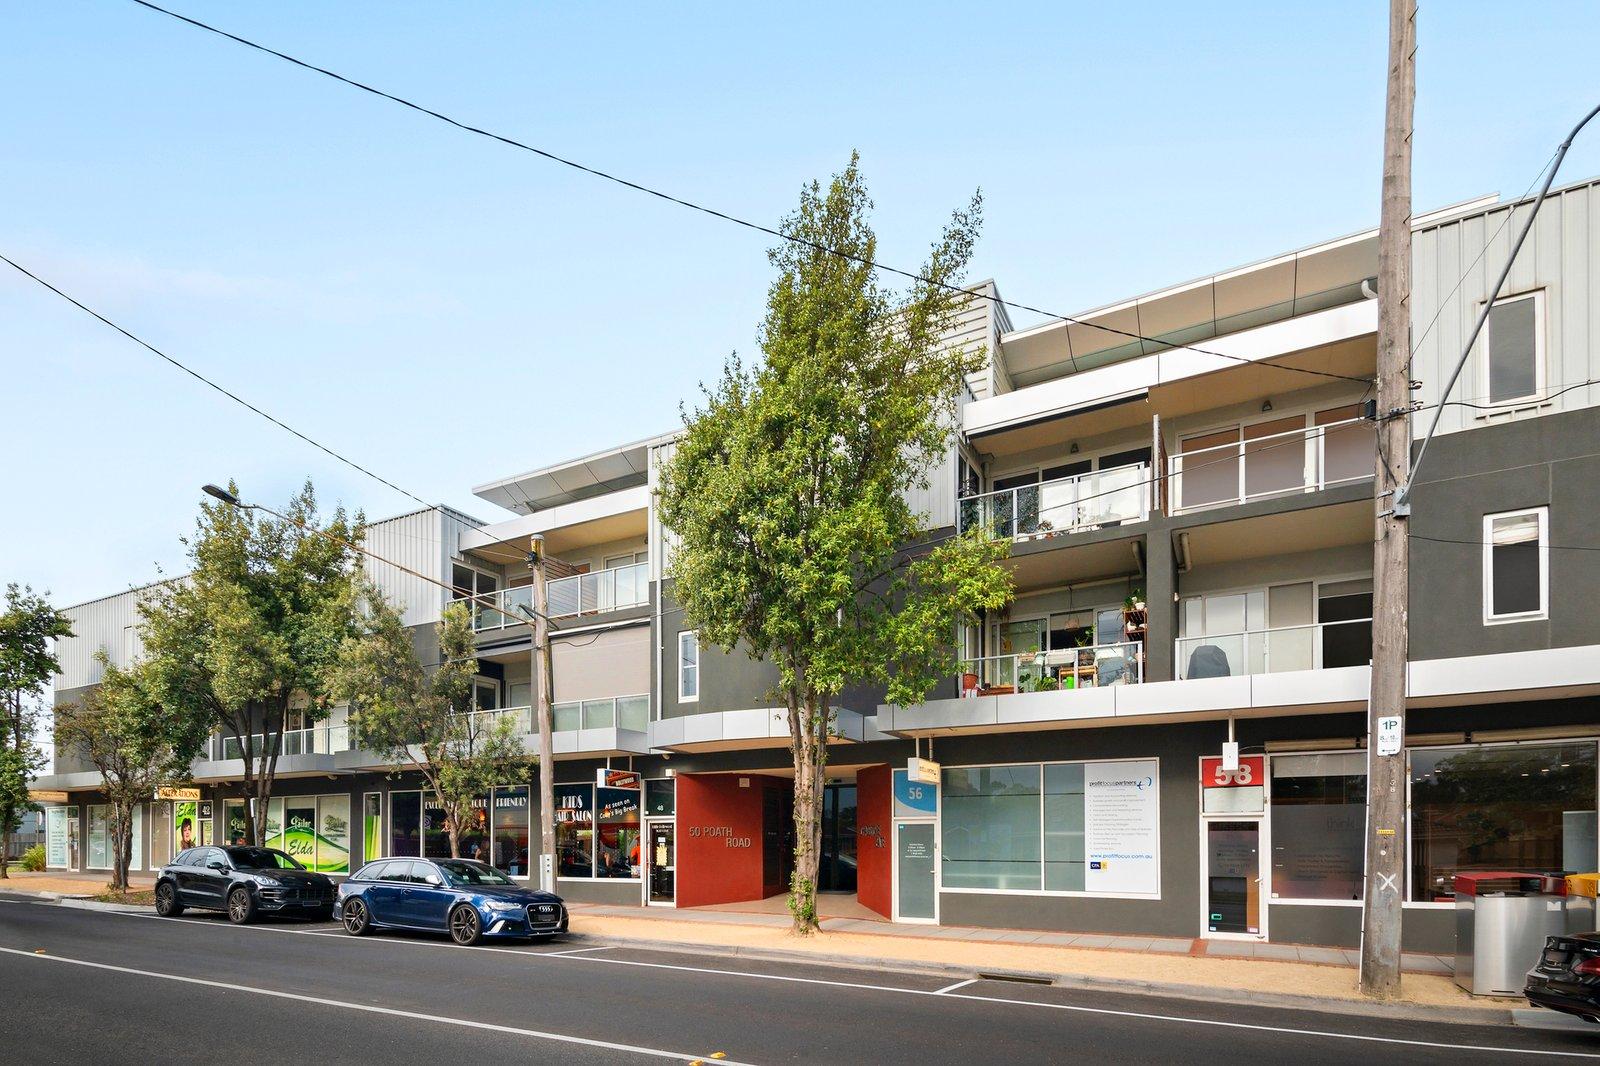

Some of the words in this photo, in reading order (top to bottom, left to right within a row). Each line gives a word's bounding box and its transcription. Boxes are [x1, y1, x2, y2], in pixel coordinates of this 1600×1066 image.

[1382, 720, 1398, 730] 1P
[1214, 764, 1252, 785] 58
[908, 787, 923, 800] 56
[496, 796, 528, 807] FRIENDLY
[562, 795, 583, 808] KIDS
[571, 810, 592, 822] SALON
[614, 807, 623, 816] Big
[689, 827, 701, 837] 50
[703, 826, 733, 837] POATH
[289, 839, 314, 856] Elda
[726, 837, 751, 848] ROAD
